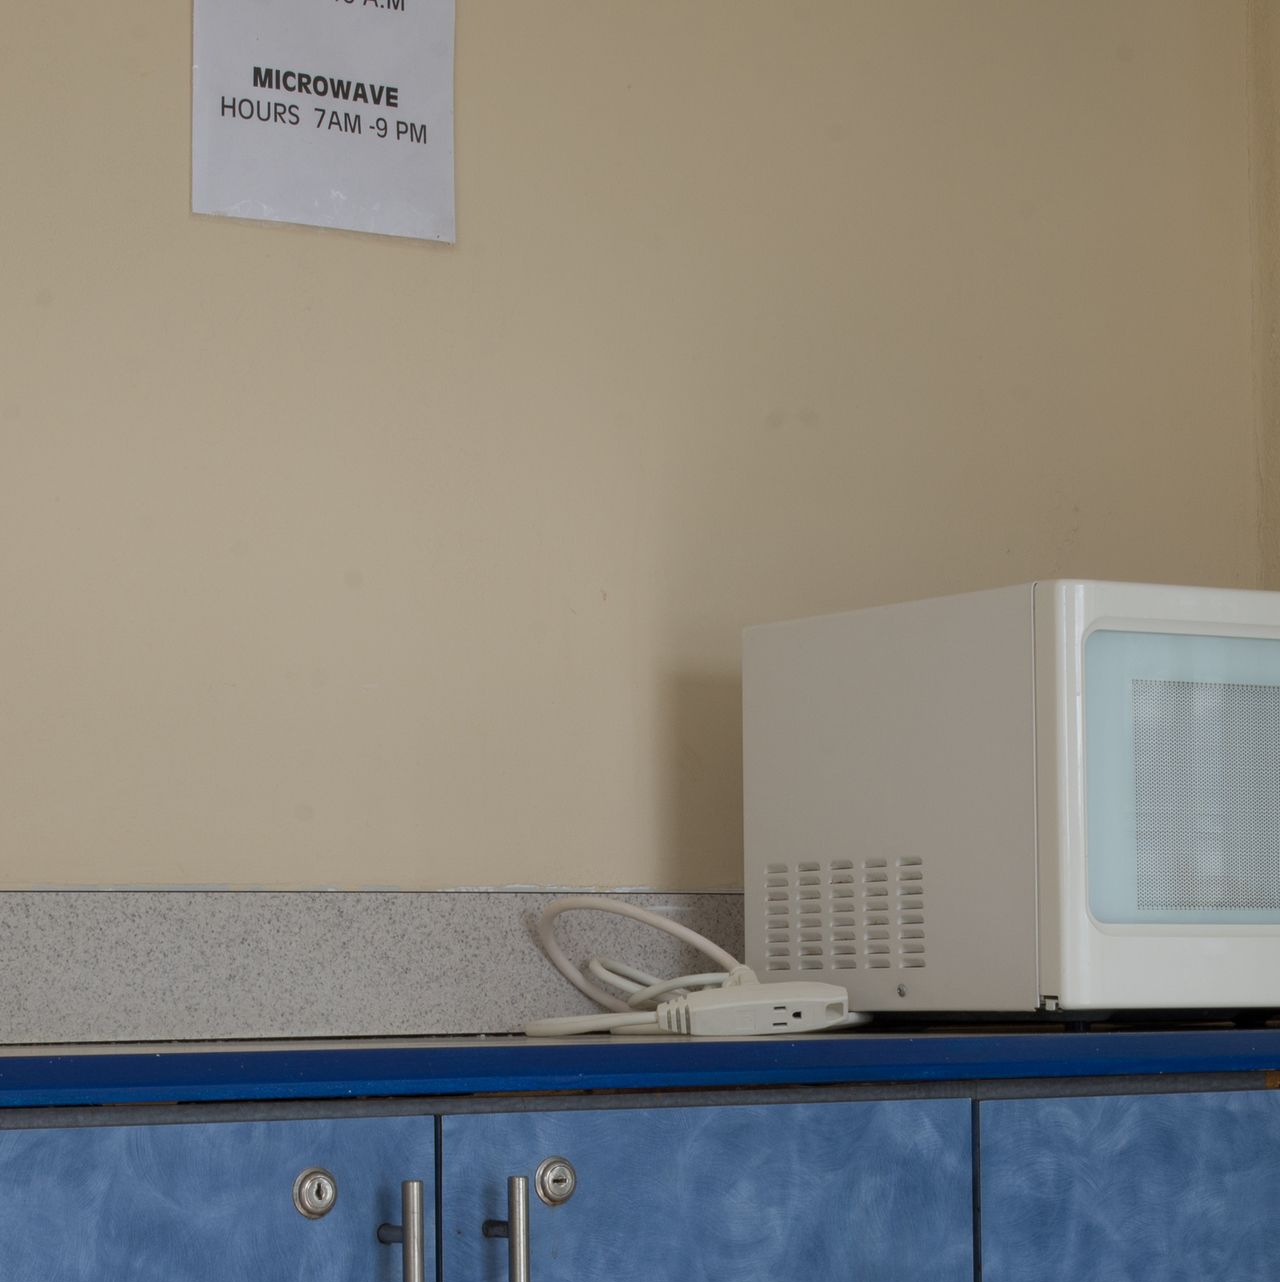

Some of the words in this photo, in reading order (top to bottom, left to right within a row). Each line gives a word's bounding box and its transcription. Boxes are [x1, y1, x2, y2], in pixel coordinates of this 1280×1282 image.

[252, 66, 399, 108] MICROWAVE
[220, 96, 300, 125] HOURS
[314, 108, 362, 134] 7AM
[396, 121, 427, 144] PM
